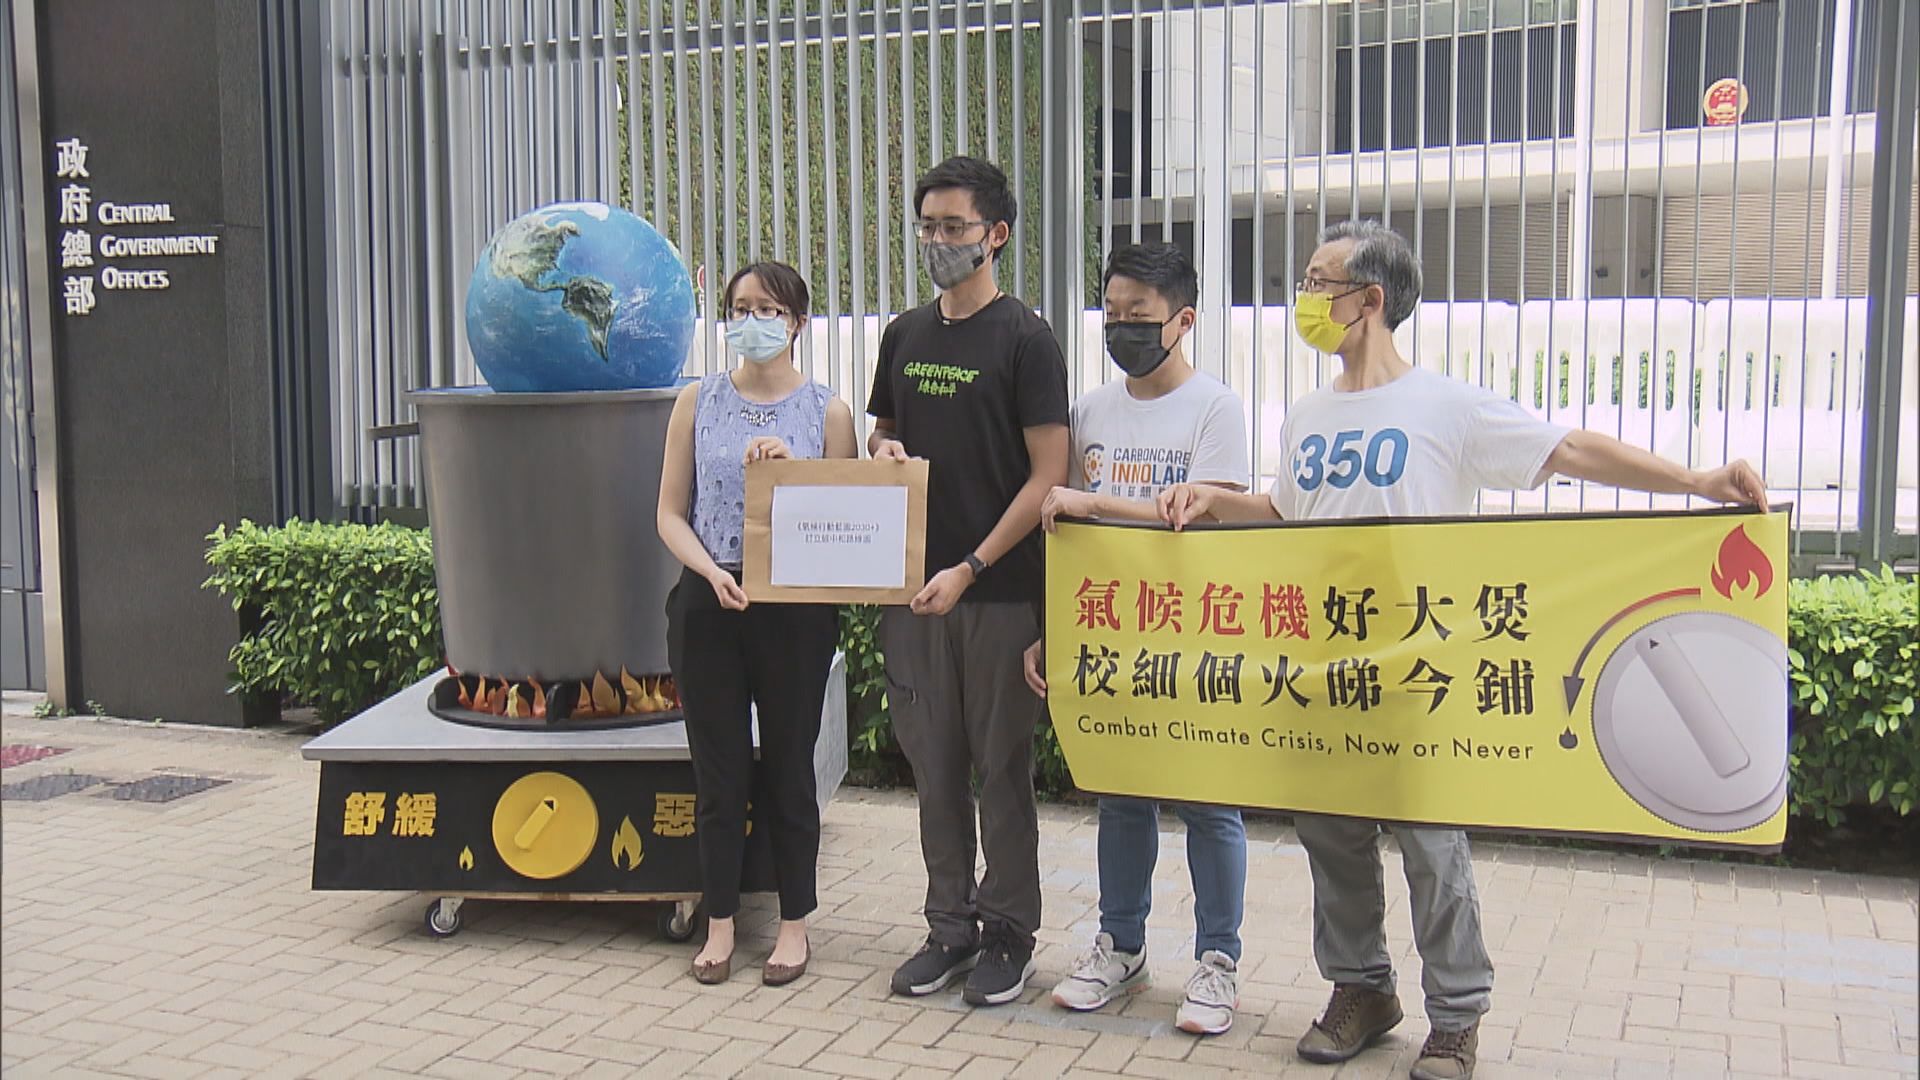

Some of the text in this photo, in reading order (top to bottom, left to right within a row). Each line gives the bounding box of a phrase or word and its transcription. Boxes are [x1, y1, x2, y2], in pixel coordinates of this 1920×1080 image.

[56, 137, 97, 316] 政府總部
[98, 202, 175, 225] CENTRAL
[100, 235, 219, 257] GOVERNMENT
[101, 267, 170, 289] OFFICES
[903, 361, 980, 384] GREENPEACE
[1112, 447, 1192, 467] CARBONCARE
[1296, 427, 1409, 492] 350
[1074, 575, 1533, 643] 氣候危機好大煲
[1072, 643, 1535, 716] 校細個火睇今鋪
[1078, 714, 1534, 760] Combat Climate Crisis, Now or Never
[342, 791, 438, 837] 舒緩
